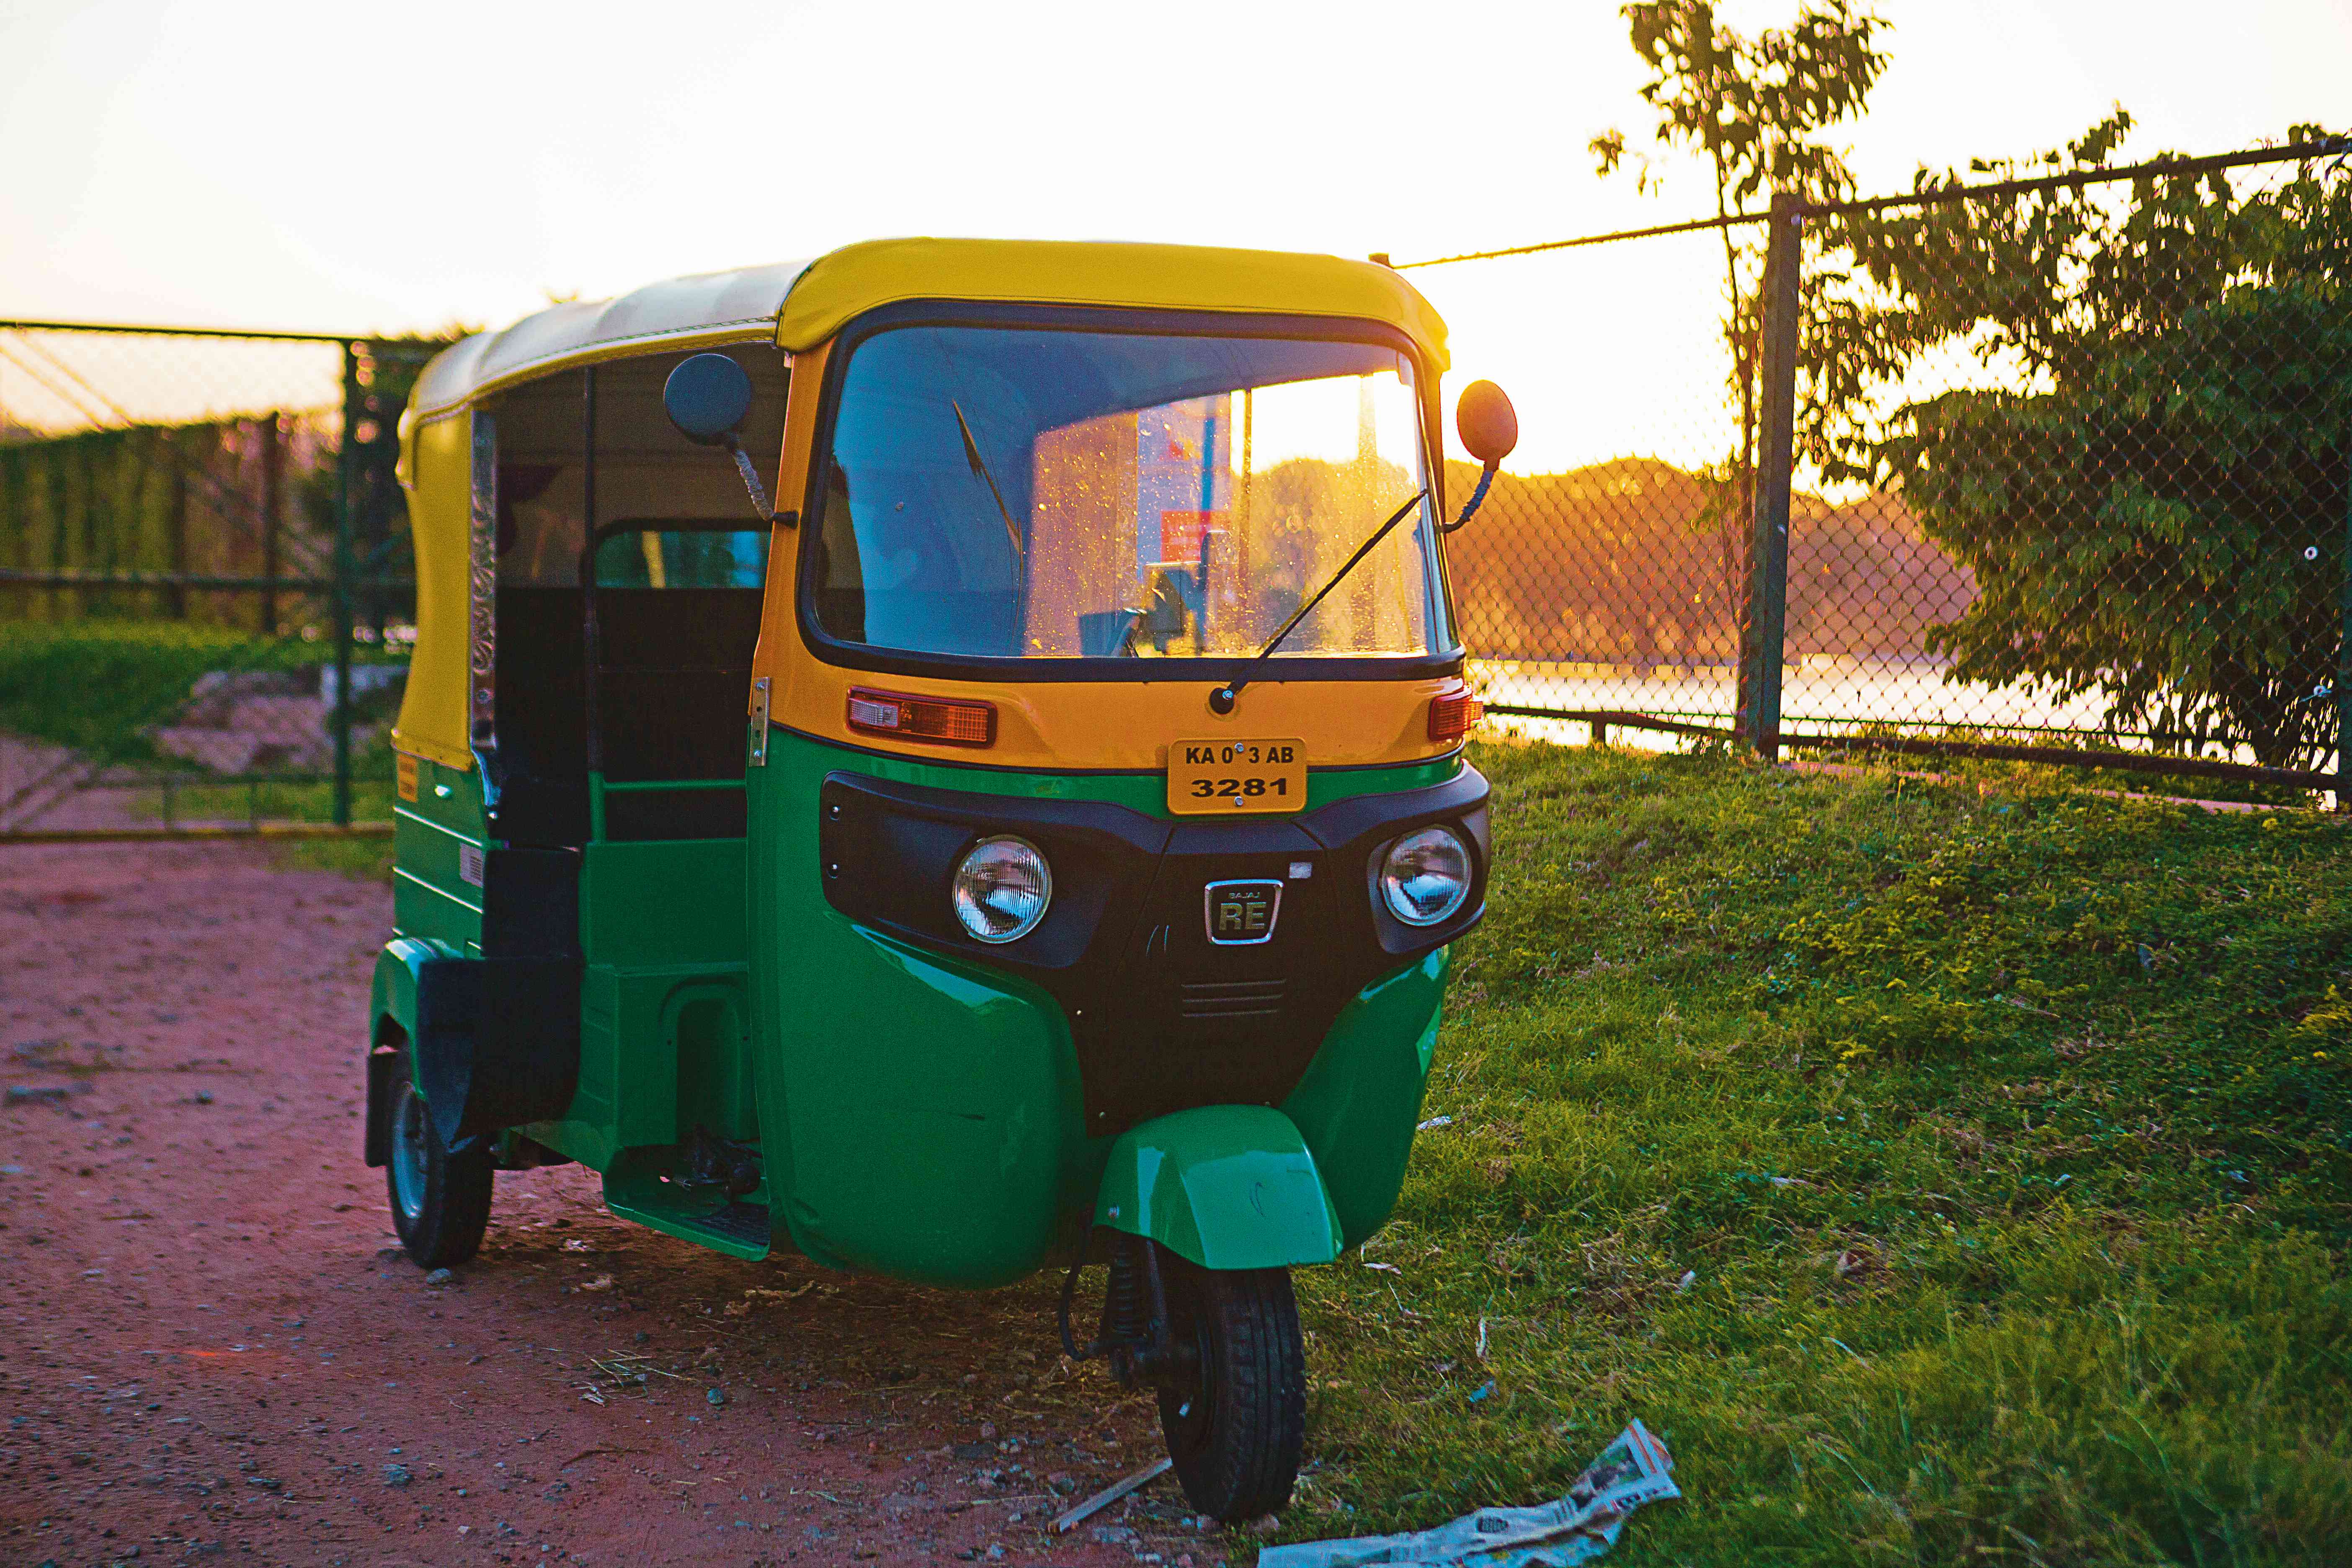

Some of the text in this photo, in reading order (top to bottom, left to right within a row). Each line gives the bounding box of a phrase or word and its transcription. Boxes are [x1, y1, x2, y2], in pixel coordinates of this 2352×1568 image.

[1186, 747, 1215, 764] KA
[1266, 746, 1294, 763] AB
[1191, 777, 1287, 798] 3281
[1219, 902, 1266, 930] RE
